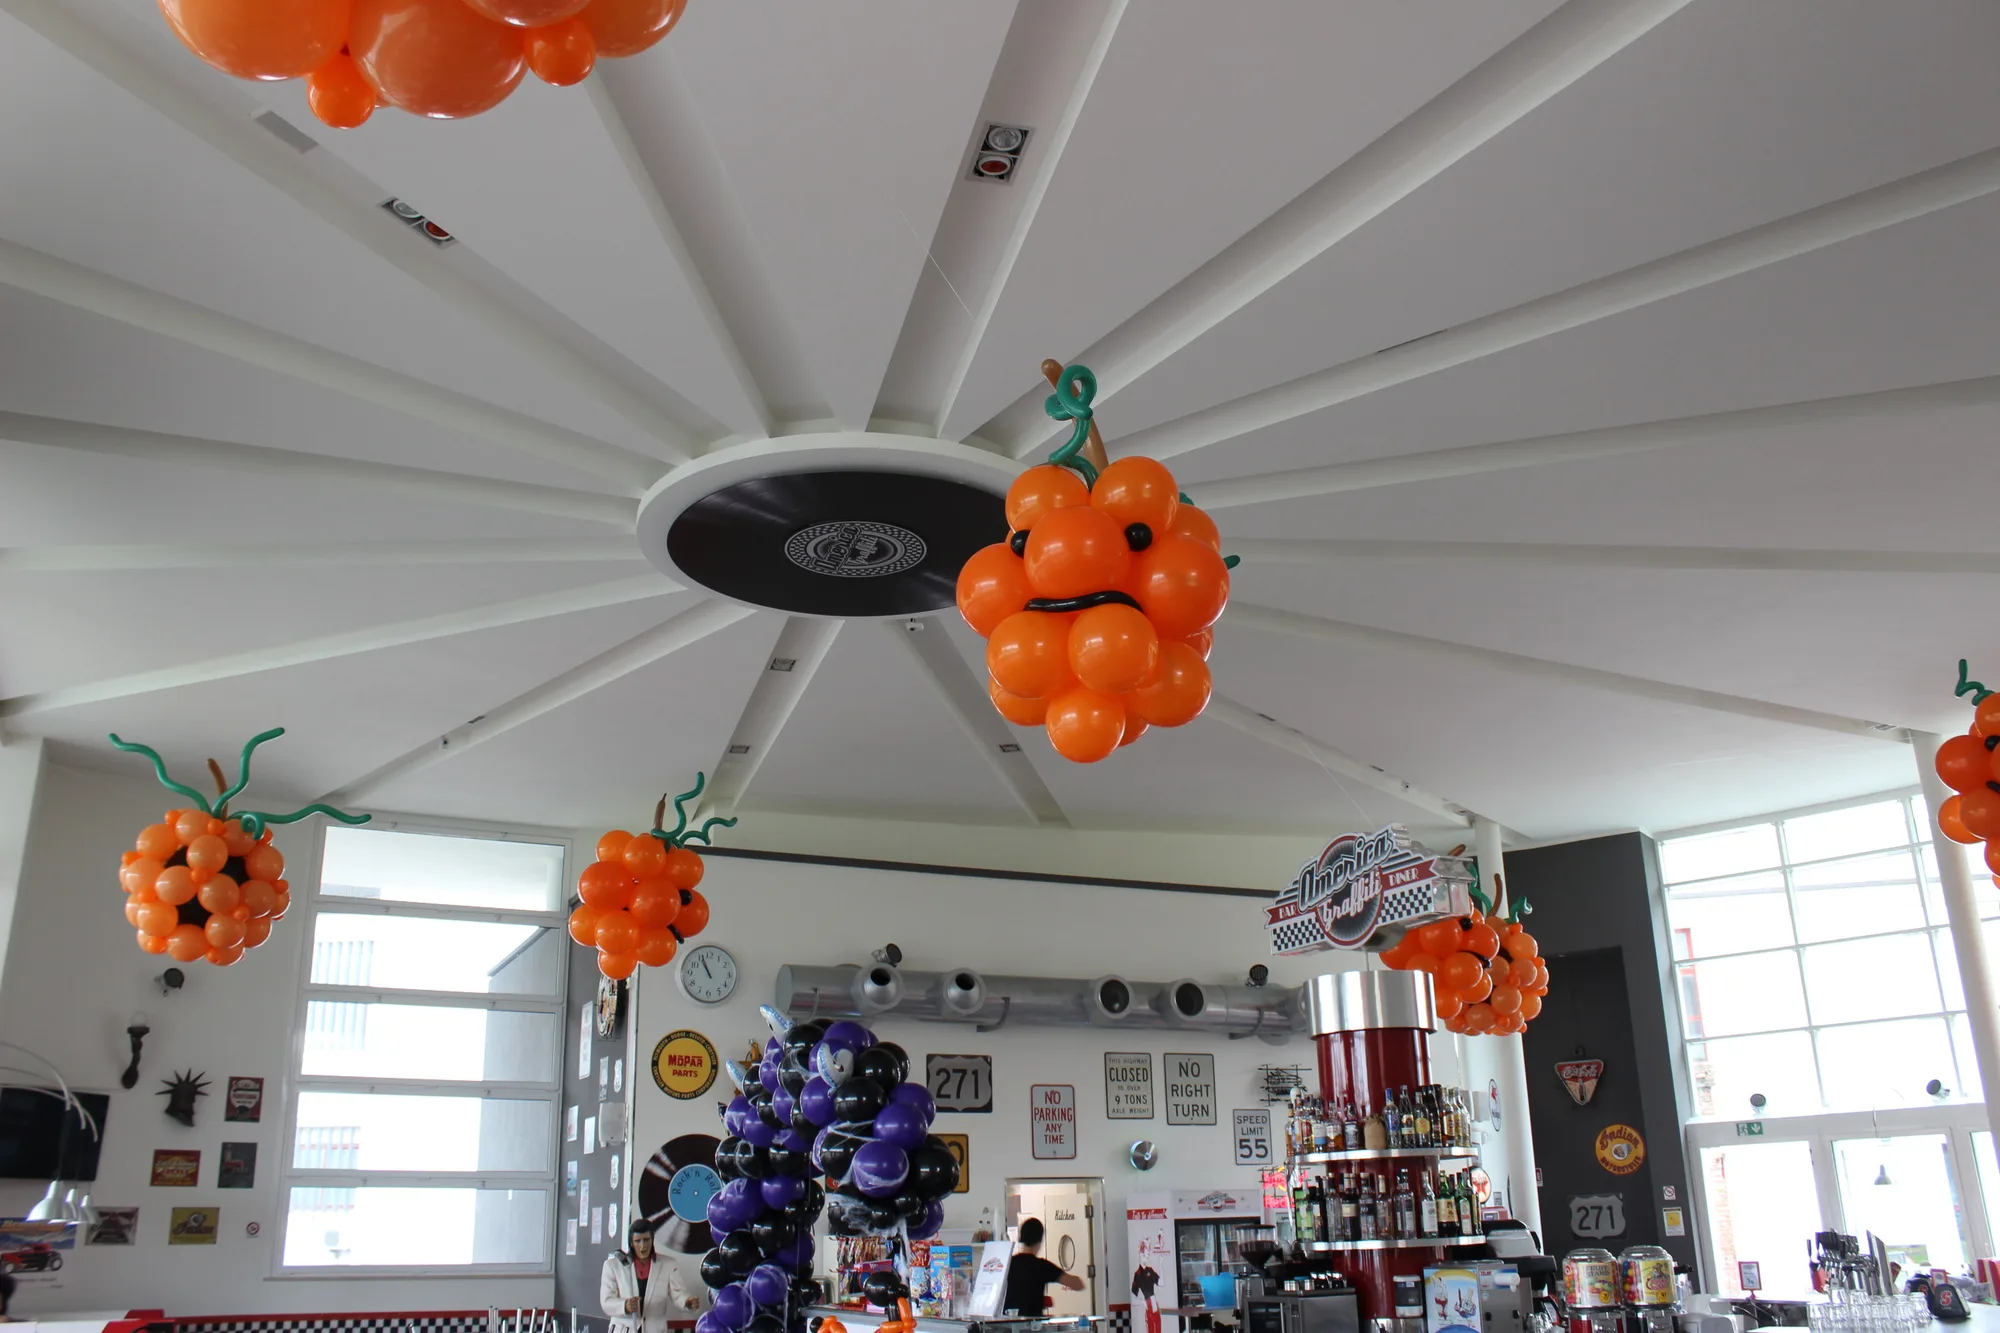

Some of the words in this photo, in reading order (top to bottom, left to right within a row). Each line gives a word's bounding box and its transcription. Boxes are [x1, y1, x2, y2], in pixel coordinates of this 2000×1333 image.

[1298, 829, 1394, 913] America
[1388, 867, 1419, 887] DINER
[1322, 870, 1383, 931] Graffiti
[1278, 905, 1298, 920] BAR
[672, 1069, 698, 1077] PARTS
[1109, 1067, 1149, 1082] CLOSED
[1179, 1062, 1200, 1077] NO
[936, 1067, 979, 1099] 271
[1171, 1084, 1210, 1097] RIGHT
[1045, 1091, 1061, 1105] NO
[1115, 1095, 1120, 1105] 9
[1124, 1094, 1148, 1104] TONS
[1034, 1107, 1073, 1122] PARKING
[1173, 1104, 1209, 1117] TURN
[1236, 1116, 1268, 1124] SPEED
[1045, 1123, 1063, 1133] ANY
[1241, 1127, 1264, 1136] LIMIT
[1044, 1135, 1064, 1144] TIME
[1600, 1127, 1640, 1151] Indian
[1239, 1138, 1268, 1159] 55
[672, 1169, 700, 1195] Rock'n
[1055, 1209, 1075, 1221] Kitchen
[1576, 1205, 1615, 1231] 271
[1940, 1290, 1952, 1306] S
